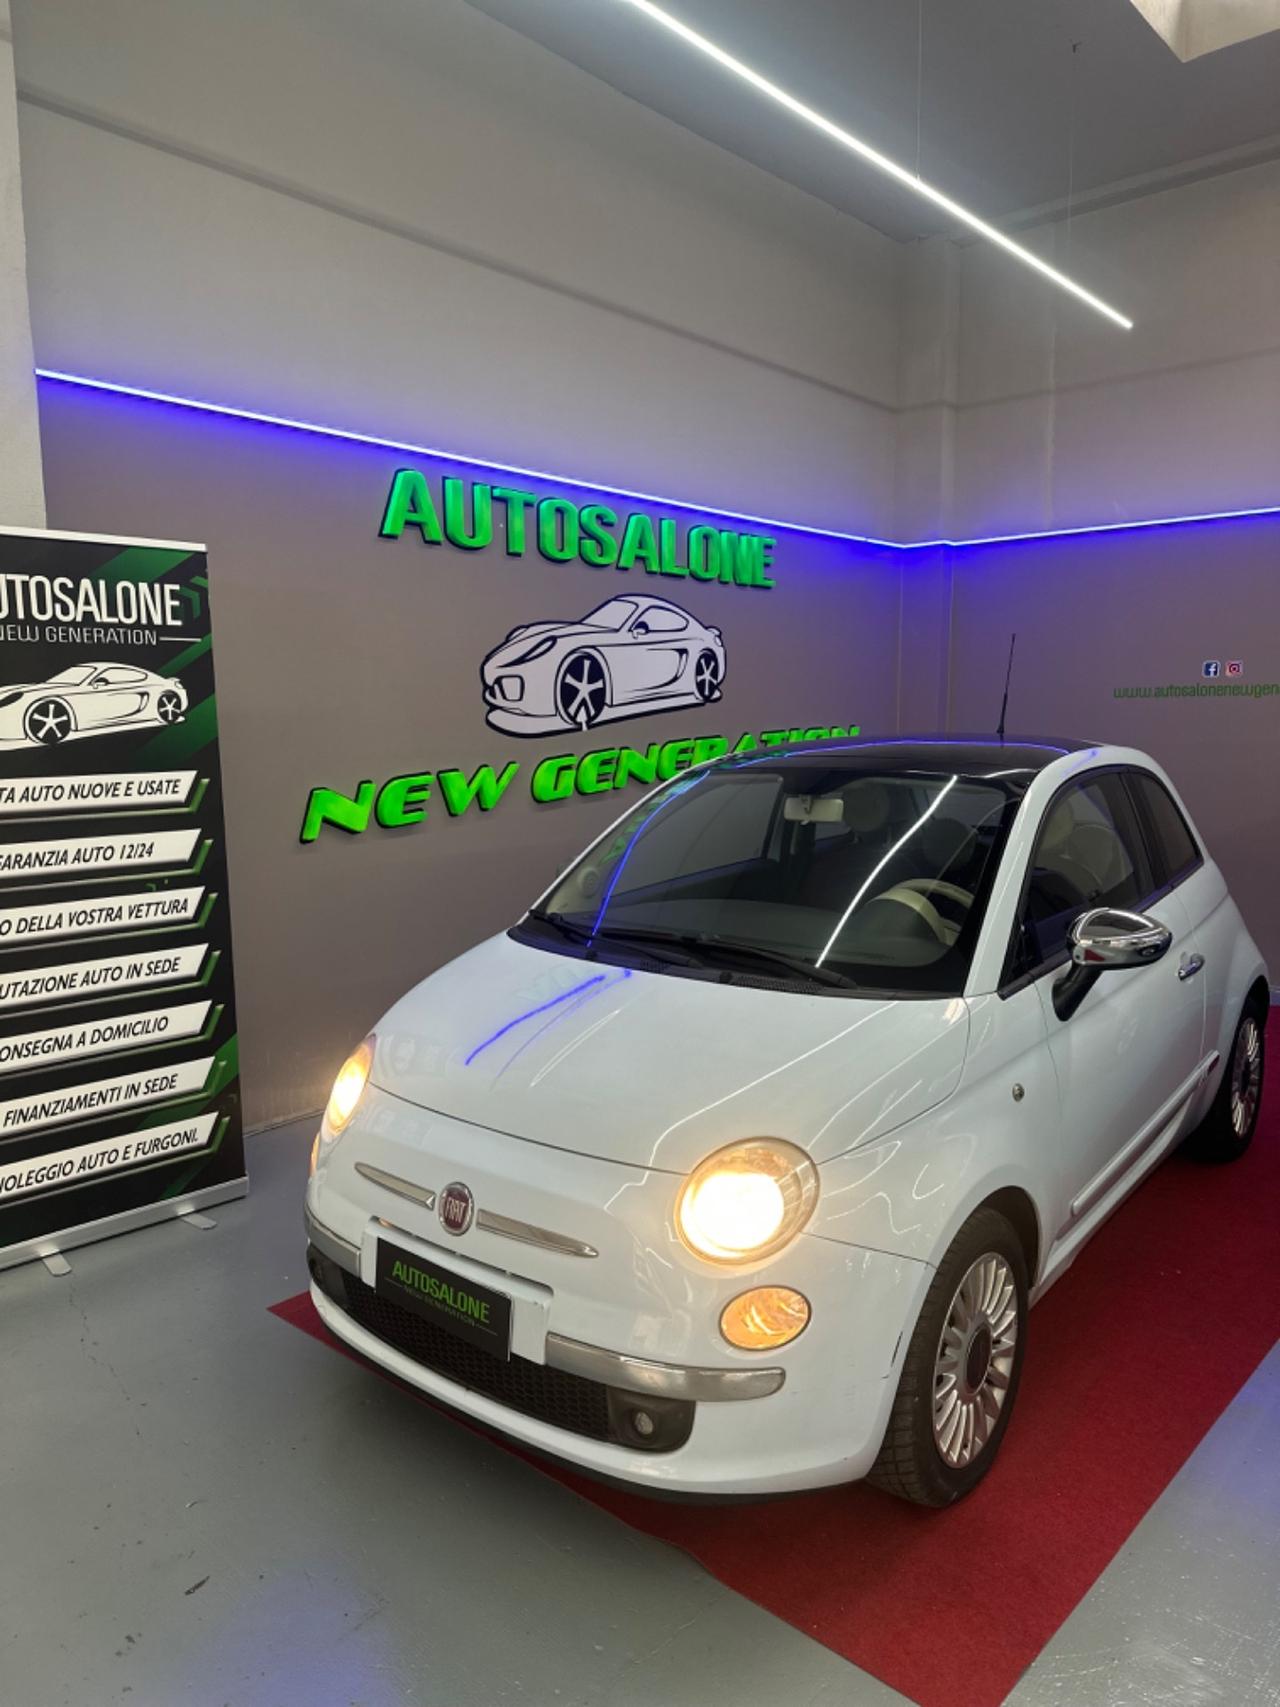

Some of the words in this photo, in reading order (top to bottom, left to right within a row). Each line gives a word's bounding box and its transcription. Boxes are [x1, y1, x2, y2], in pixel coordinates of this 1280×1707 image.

[379, 469, 778, 589] AUTOSALONE
[45, 626, 157, 646] GENERATION
[19, 784, 65, 803] AUTO
[67, 781, 124, 800] NUOVE
[124, 780, 134, 798] E
[137, 778, 181, 797] USATE
[300, 761, 520, 844] NEW
[530, 725, 862, 803] GENER
[71, 845, 115, 865] AUTO
[119, 842, 155, 861] 12/24
[15, 913, 63, 935] DELLA
[68, 905, 123, 927] VOSTRA
[127, 898, 189, 921] VETTURA
[80, 966, 123, 989] AUTO
[126, 963, 143, 980] IN
[144, 957, 182, 977] SEDE
[76, 1030, 86, 1048] A
[90, 1016, 170, 1045] DOMICILIO
[3, 1086, 122, 1128] FINANZIAMENTI
[124, 1082, 142, 1099] IN
[143, 1073, 179, 1095] SEDE
[76, 1149, 119, 1174] AUTO
[121, 1144, 132, 1162] E
[443, 1196, 467, 1223] FIAT
[391, 1260, 491, 1324] AUTOSALONE
